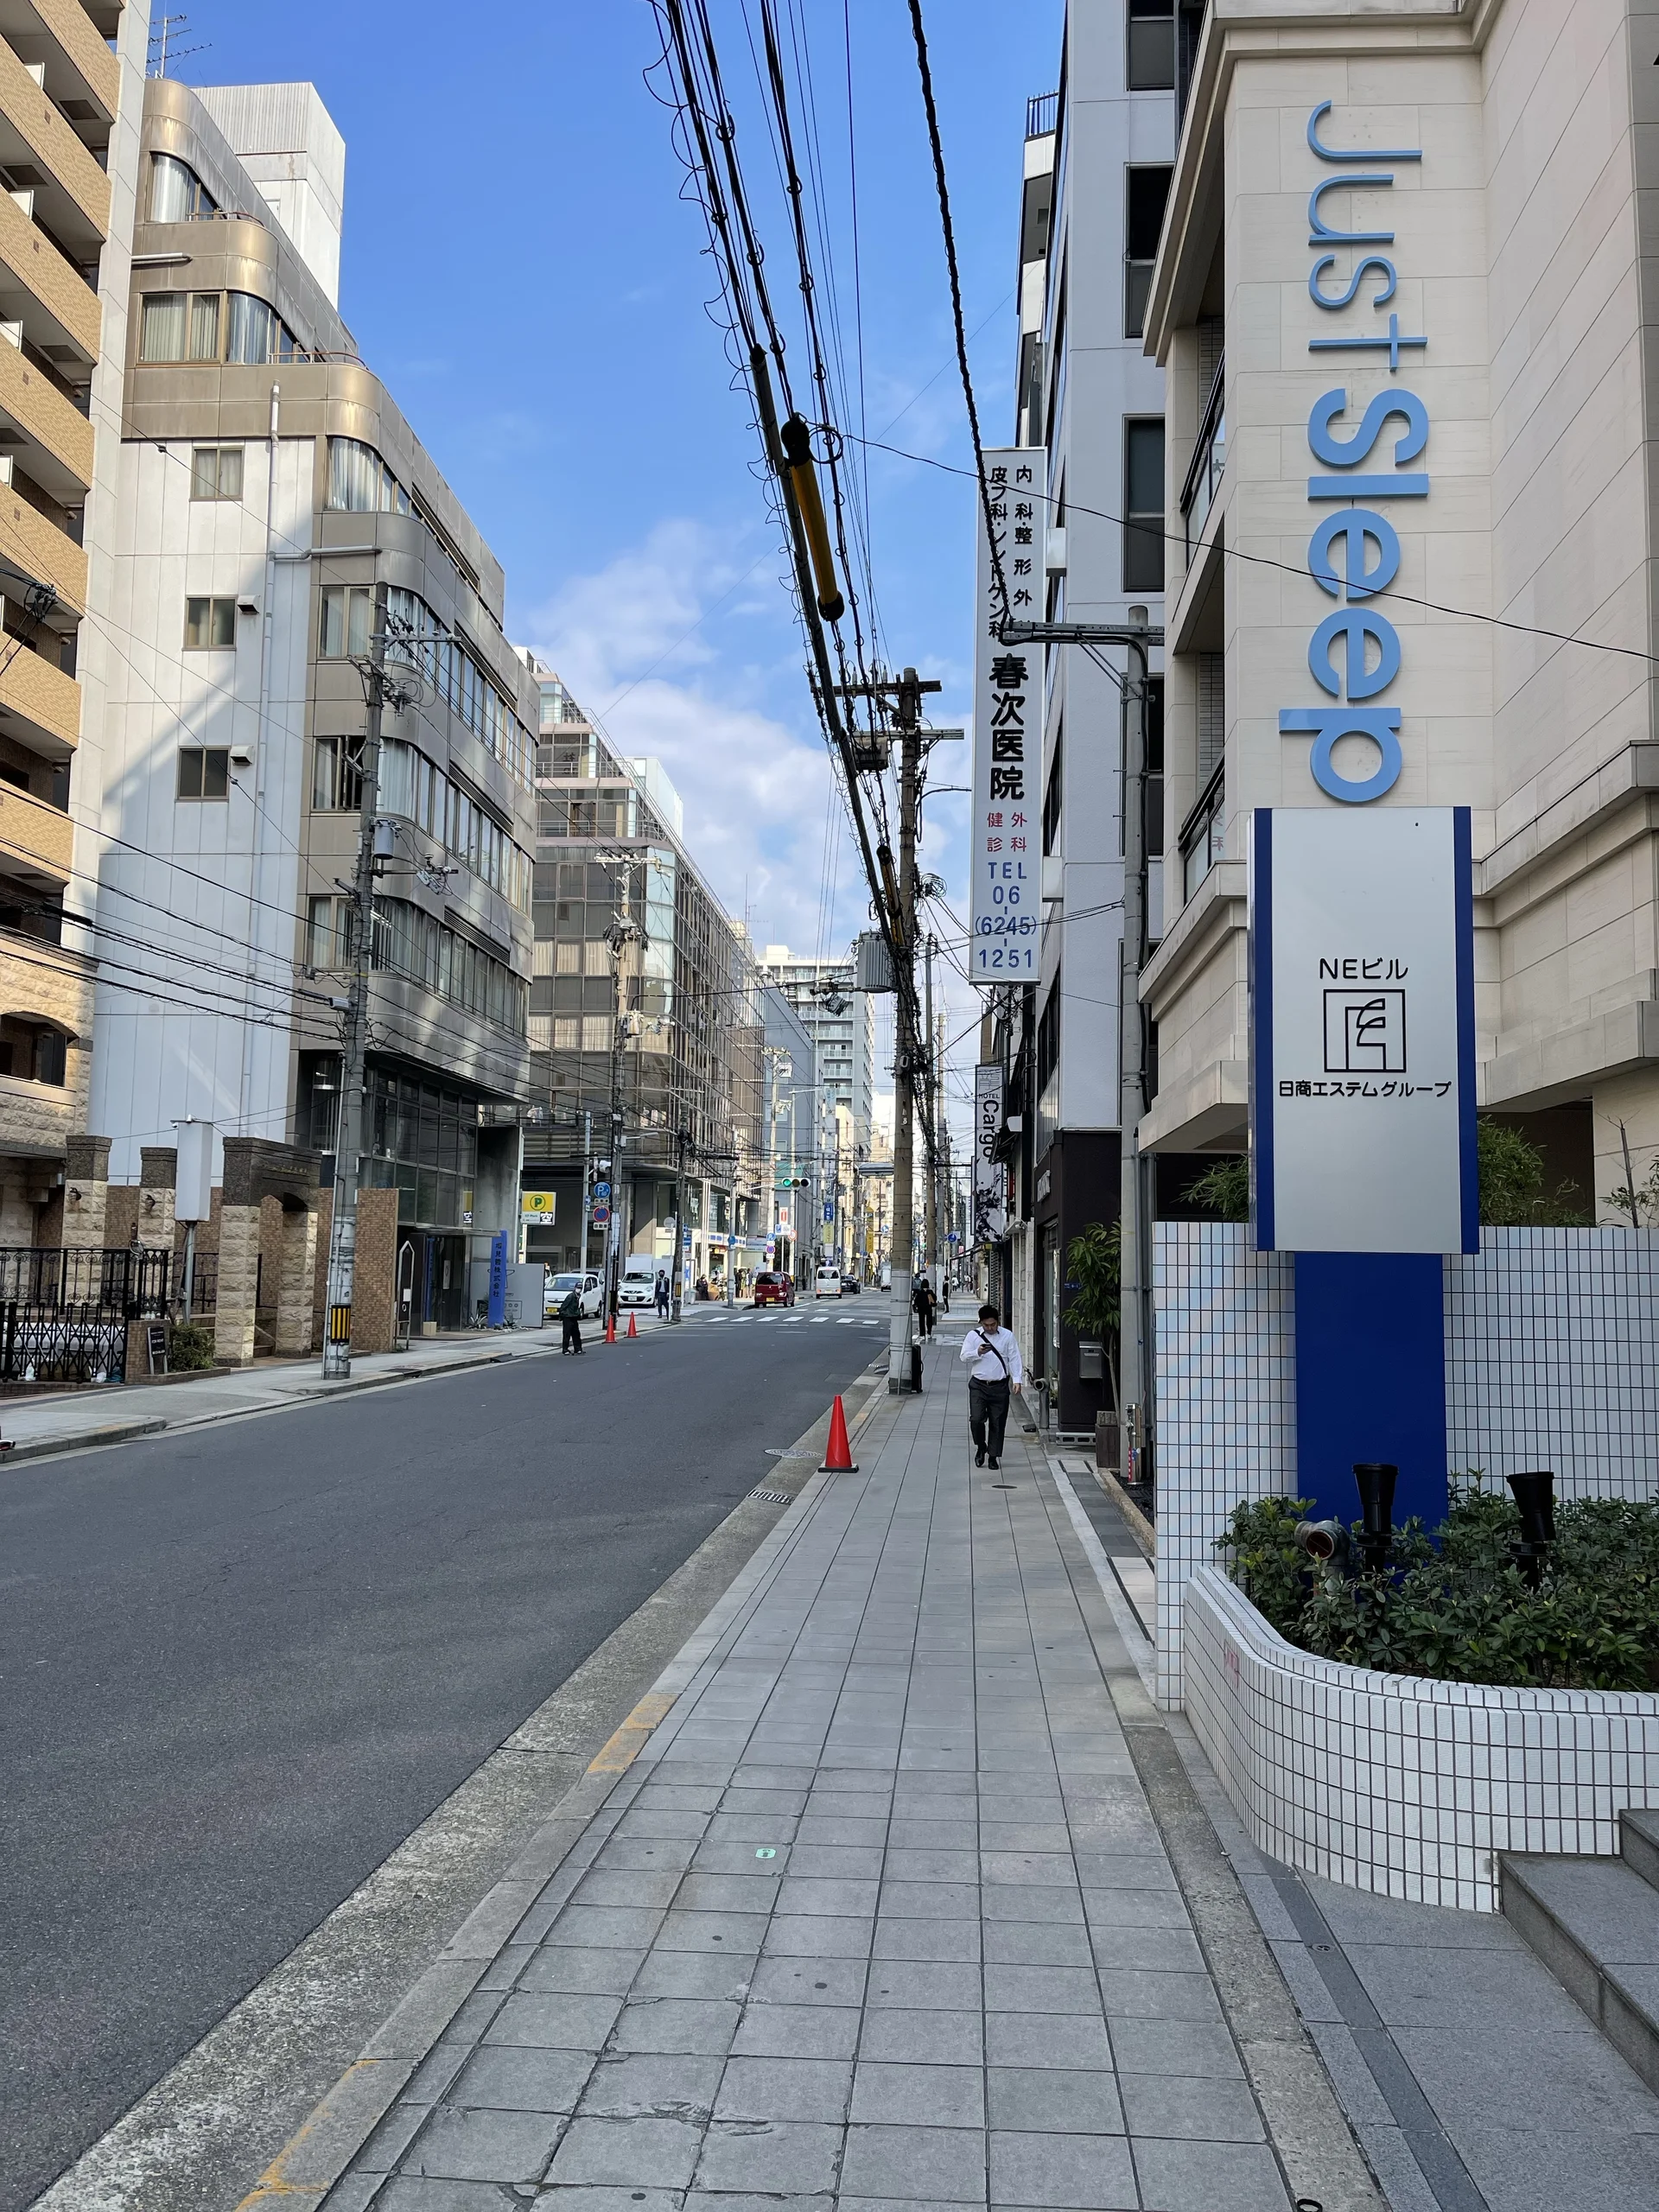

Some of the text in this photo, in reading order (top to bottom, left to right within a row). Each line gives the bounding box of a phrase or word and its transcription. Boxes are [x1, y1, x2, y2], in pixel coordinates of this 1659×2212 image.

[1014, 465, 1033, 624] 内科・整形外
[988, 652, 1029, 801] 春次医院
[988, 861, 1027, 880] TEL
[993, 885, 1020, 905] 06
[975, 915, 1037, 937] (6245)
[978, 949, 1033, 969] 1251
[1319, 957, 1409, 980] NEビル
[1279, 1080, 1452, 1097] 日商エステムグループ
[978, 1099, 1000, 1159] Cargo
